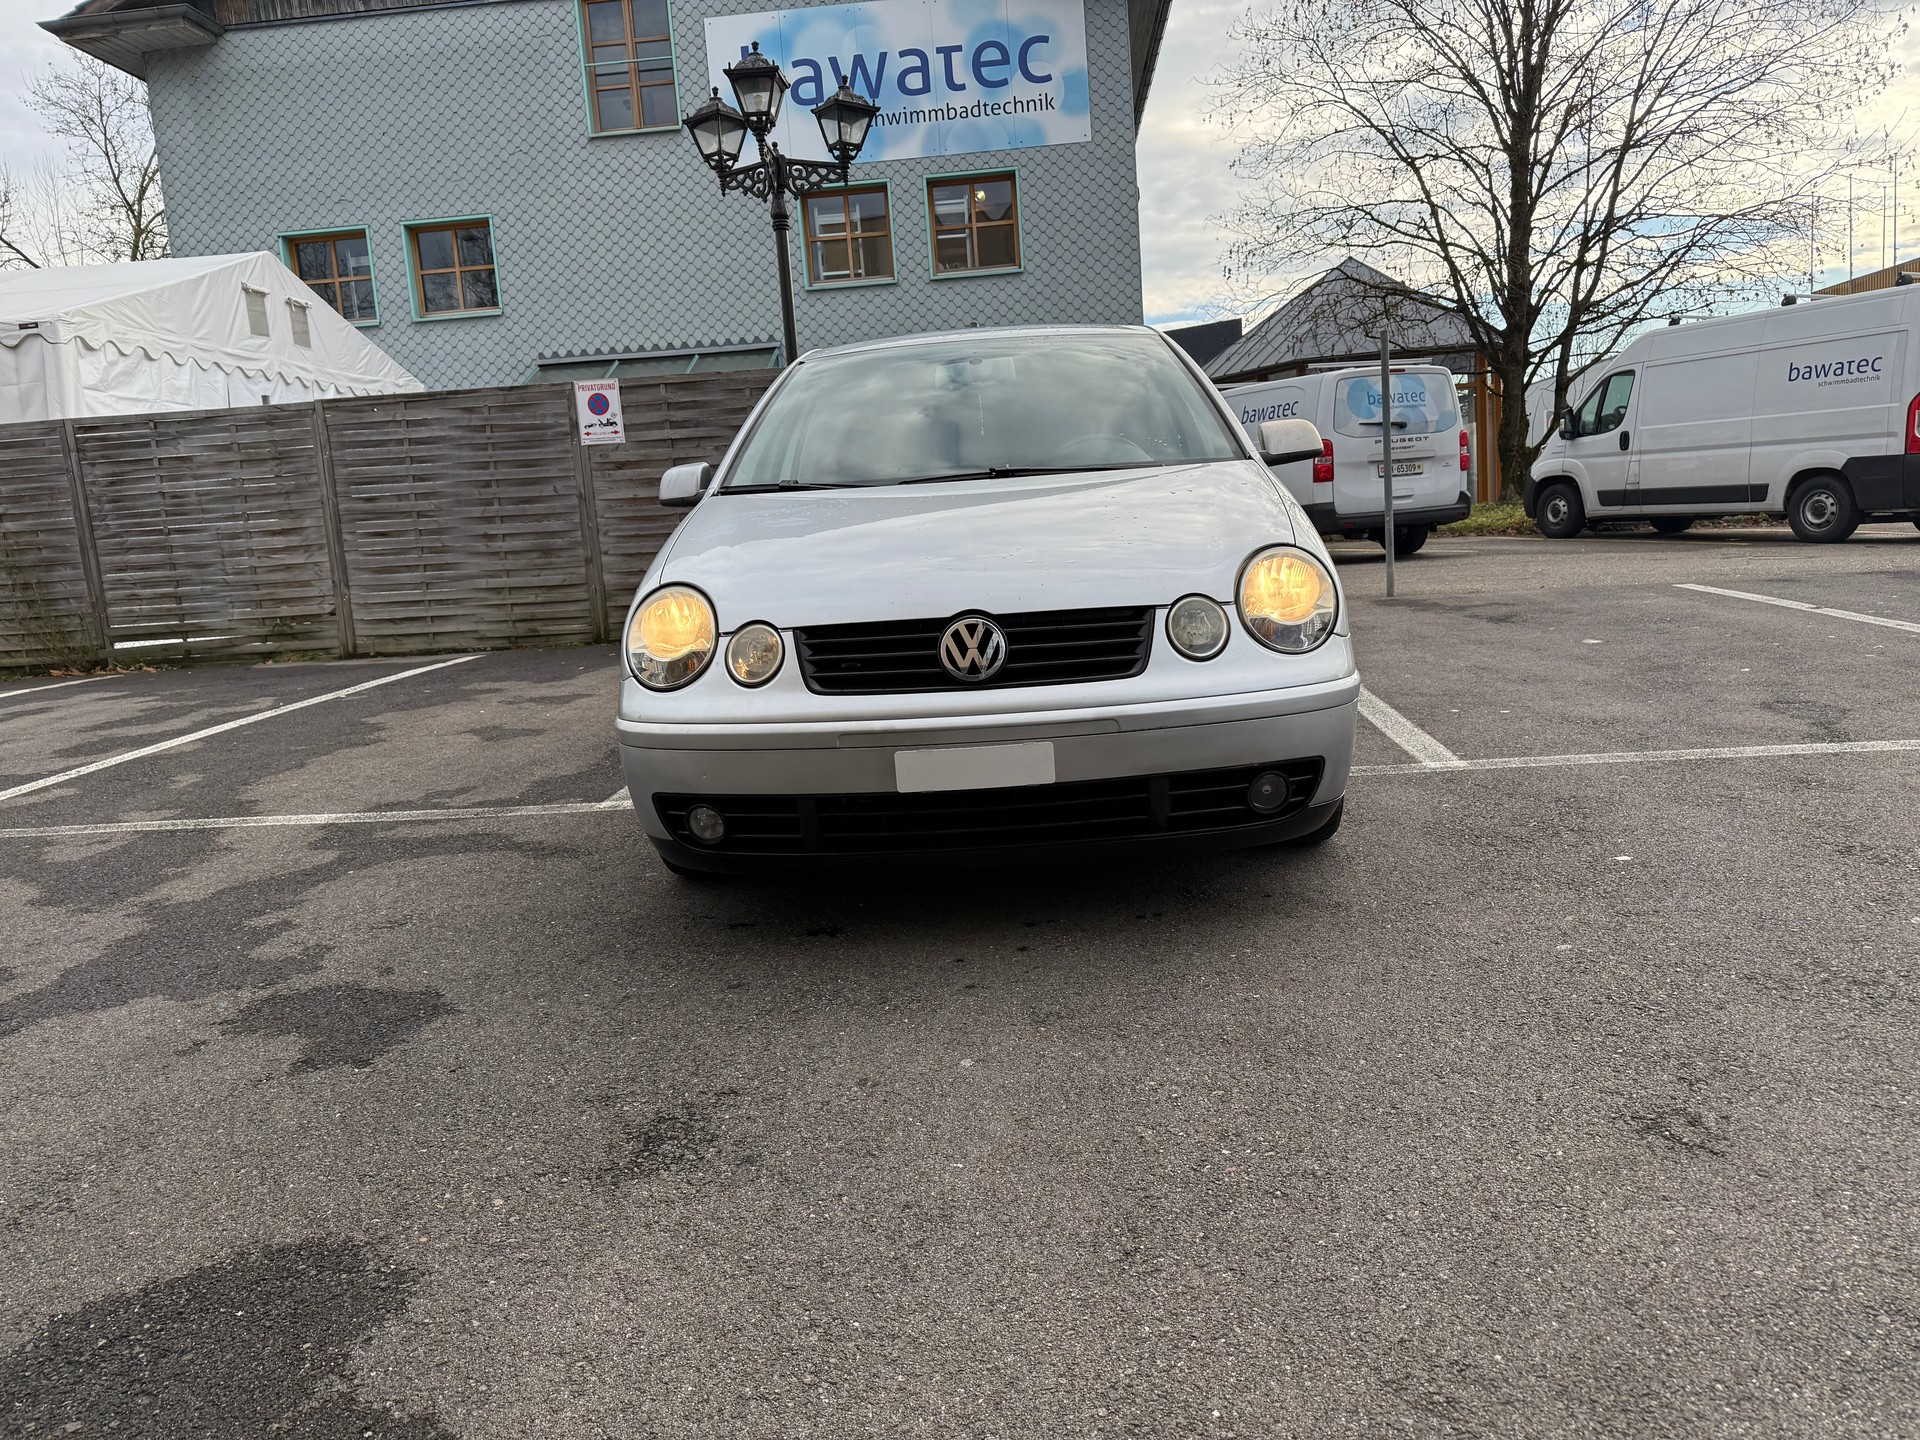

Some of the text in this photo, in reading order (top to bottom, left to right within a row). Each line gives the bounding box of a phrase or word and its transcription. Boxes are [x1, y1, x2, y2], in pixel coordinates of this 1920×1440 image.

[740, 35, 1053, 106] awatec
[870, 93, 1055, 127] hwimmbadtechnik
[1788, 356, 1882, 382] bawatec
[1817, 375, 1881, 387] schwimmbadtechnik
[578, 383, 616, 392] PRIVATGRUND
[1241, 400, 1299, 424] bawatec
[1375, 436, 1429, 444] PUGEOT
